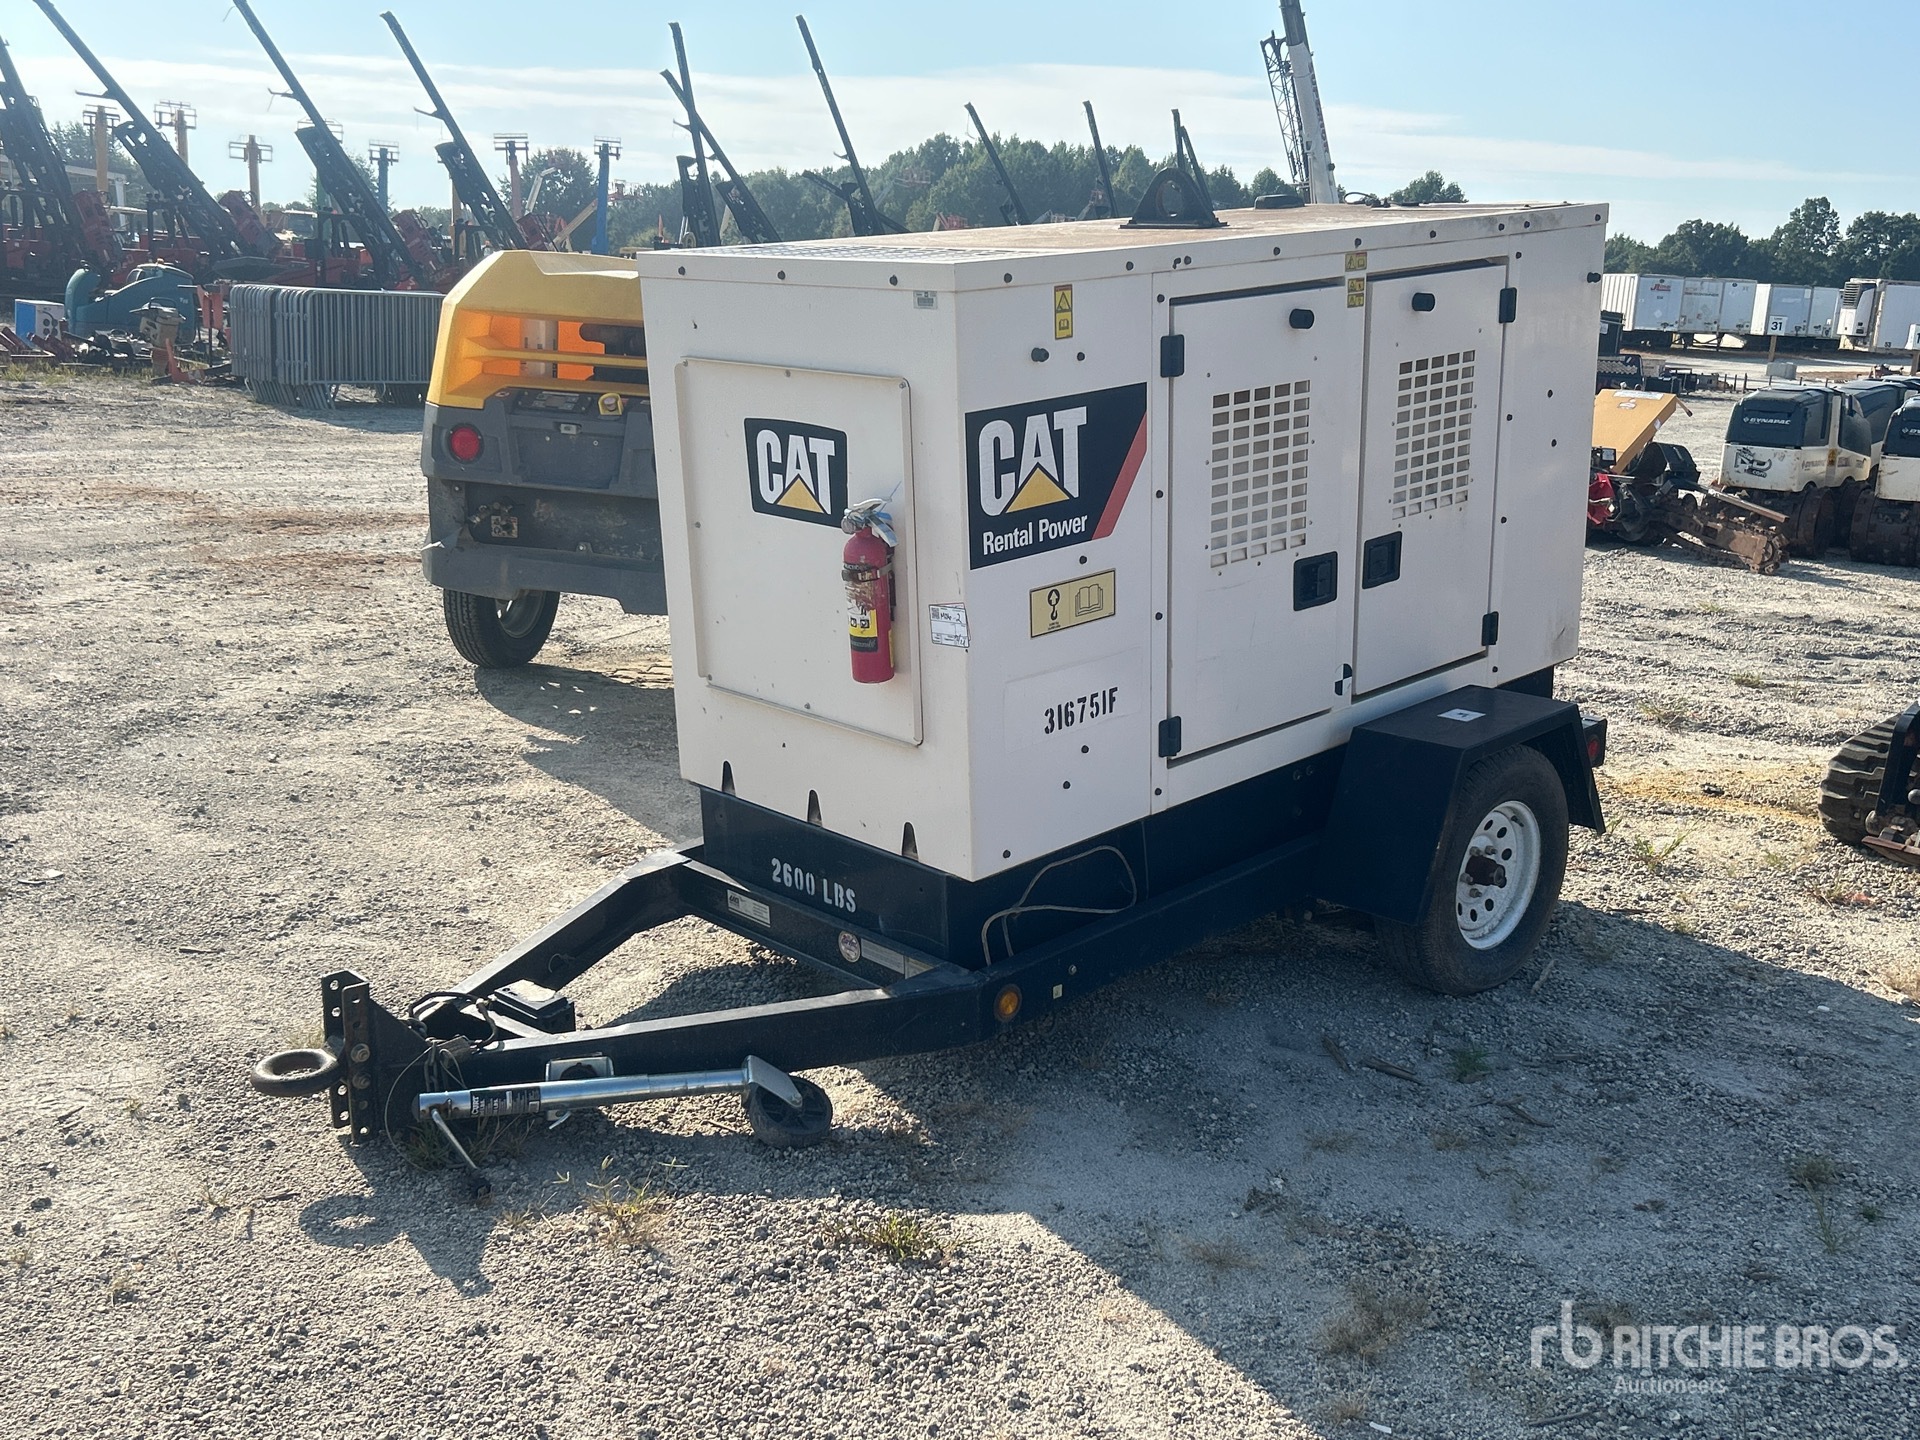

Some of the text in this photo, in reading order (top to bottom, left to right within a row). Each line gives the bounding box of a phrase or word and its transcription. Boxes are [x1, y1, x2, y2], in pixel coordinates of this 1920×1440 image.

[1771, 321, 1783, 331] 31
[1749, 417, 1791, 425] DYNAPAC
[756, 429, 835, 515] CAT
[978, 406, 1087, 516] CAT
[982, 514, 1088, 555] Rental Power
[771, 857, 857, 913] 2600 LBS
